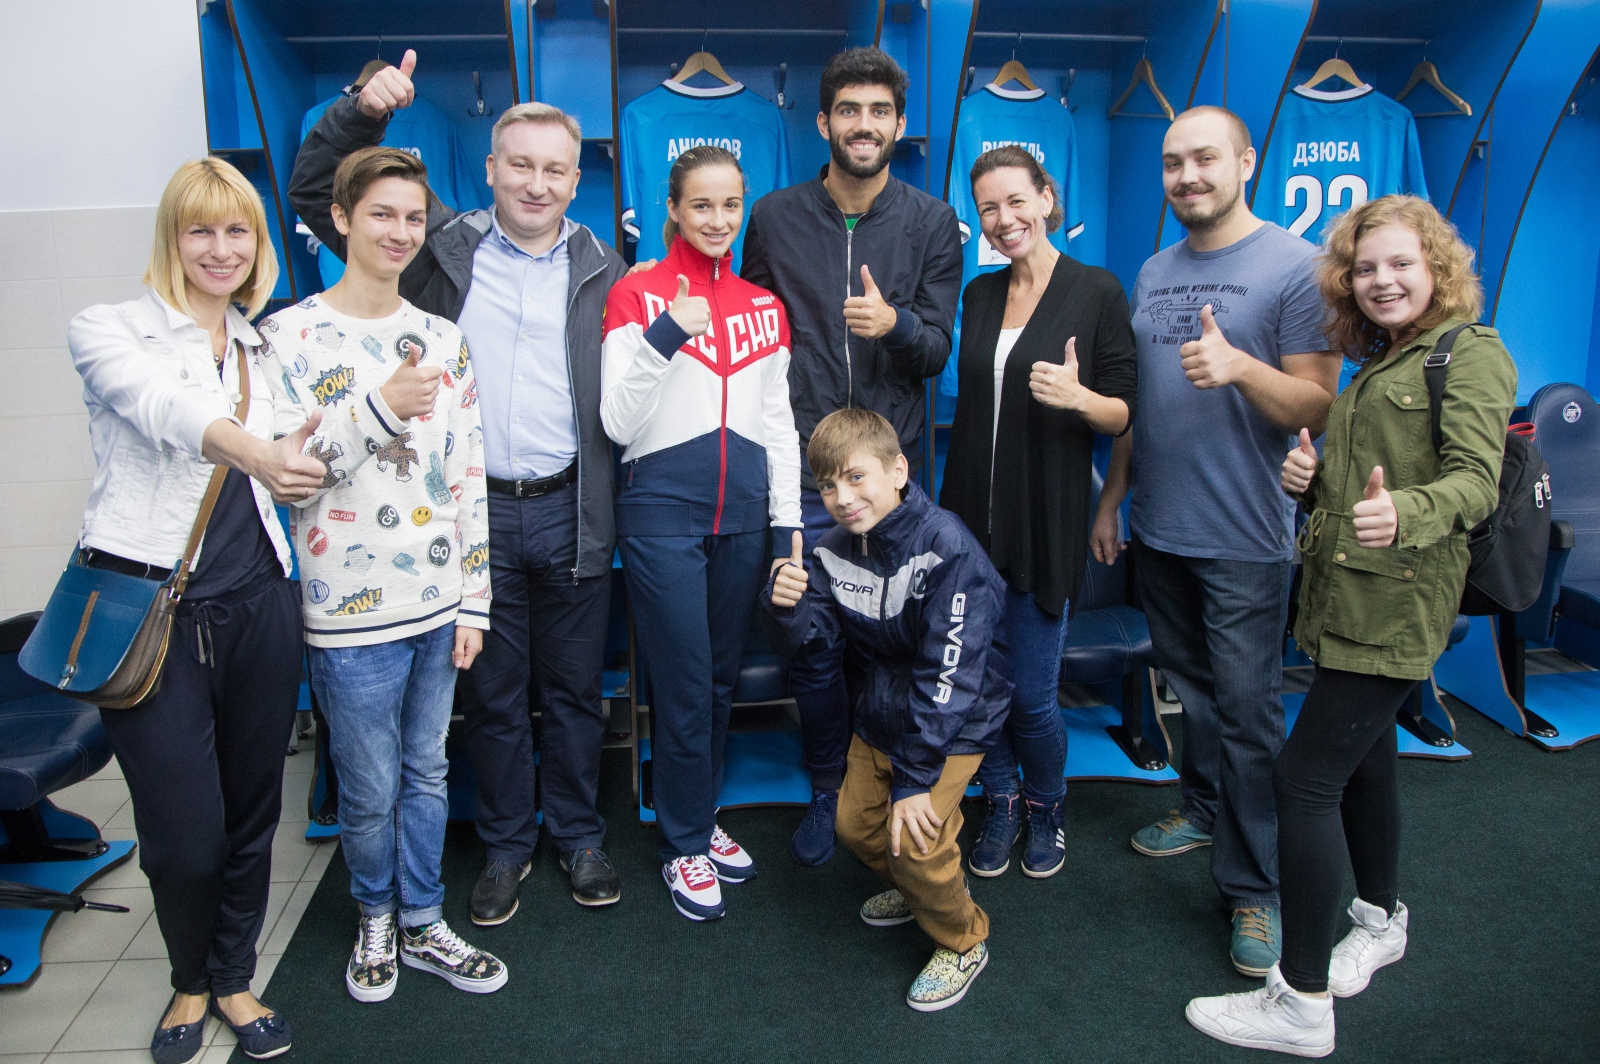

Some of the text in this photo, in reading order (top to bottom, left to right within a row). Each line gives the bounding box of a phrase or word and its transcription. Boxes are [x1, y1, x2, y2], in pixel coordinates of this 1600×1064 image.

[1293, 141, 1360, 167] ДЗЮБА
[1147, 287, 1170, 299] STRONG
[1191, 284, 1219, 293] WEARING
[1220, 284, 1249, 297] APPAREL
[1168, 325, 1194, 334] CRAFTED
[1160, 335, 1179, 345] TOUGH
[314, 368, 354, 406] POW!
[340, 513, 354, 521] FUN
[381, 507, 396, 526] GO
[430, 544, 449, 560] GO
[831, 576, 874, 596] IVOVA
[932, 592, 967, 705] GIVOVA
